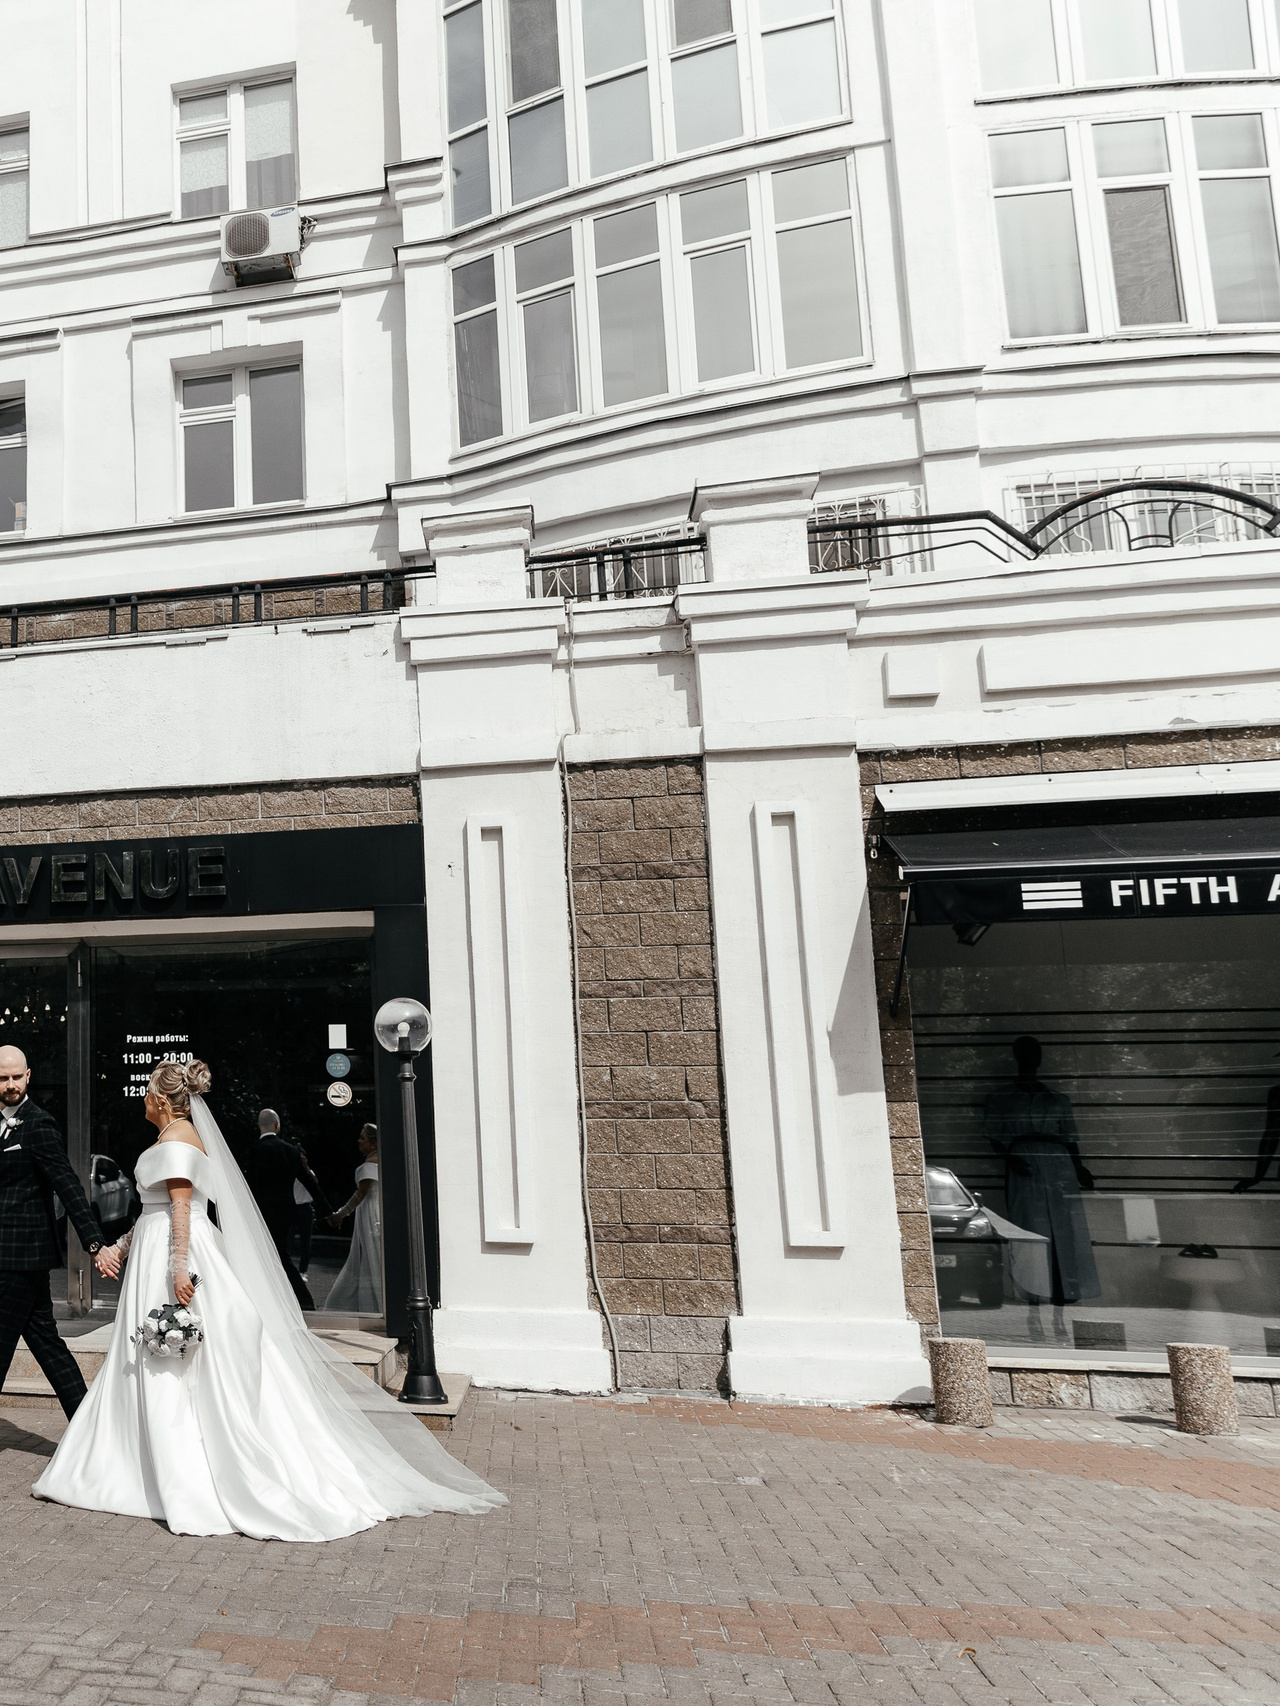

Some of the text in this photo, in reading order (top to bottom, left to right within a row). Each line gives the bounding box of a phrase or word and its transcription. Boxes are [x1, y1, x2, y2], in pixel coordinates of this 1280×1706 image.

[1110, 875, 1239, 907] FIFTH
[126, 1033, 189, 1044] Режим работы:
[122, 1052, 152, 1064] 11:00
[163, 1052, 193, 1063] 20:00
[122, 1085, 149, 1097] 12:0
